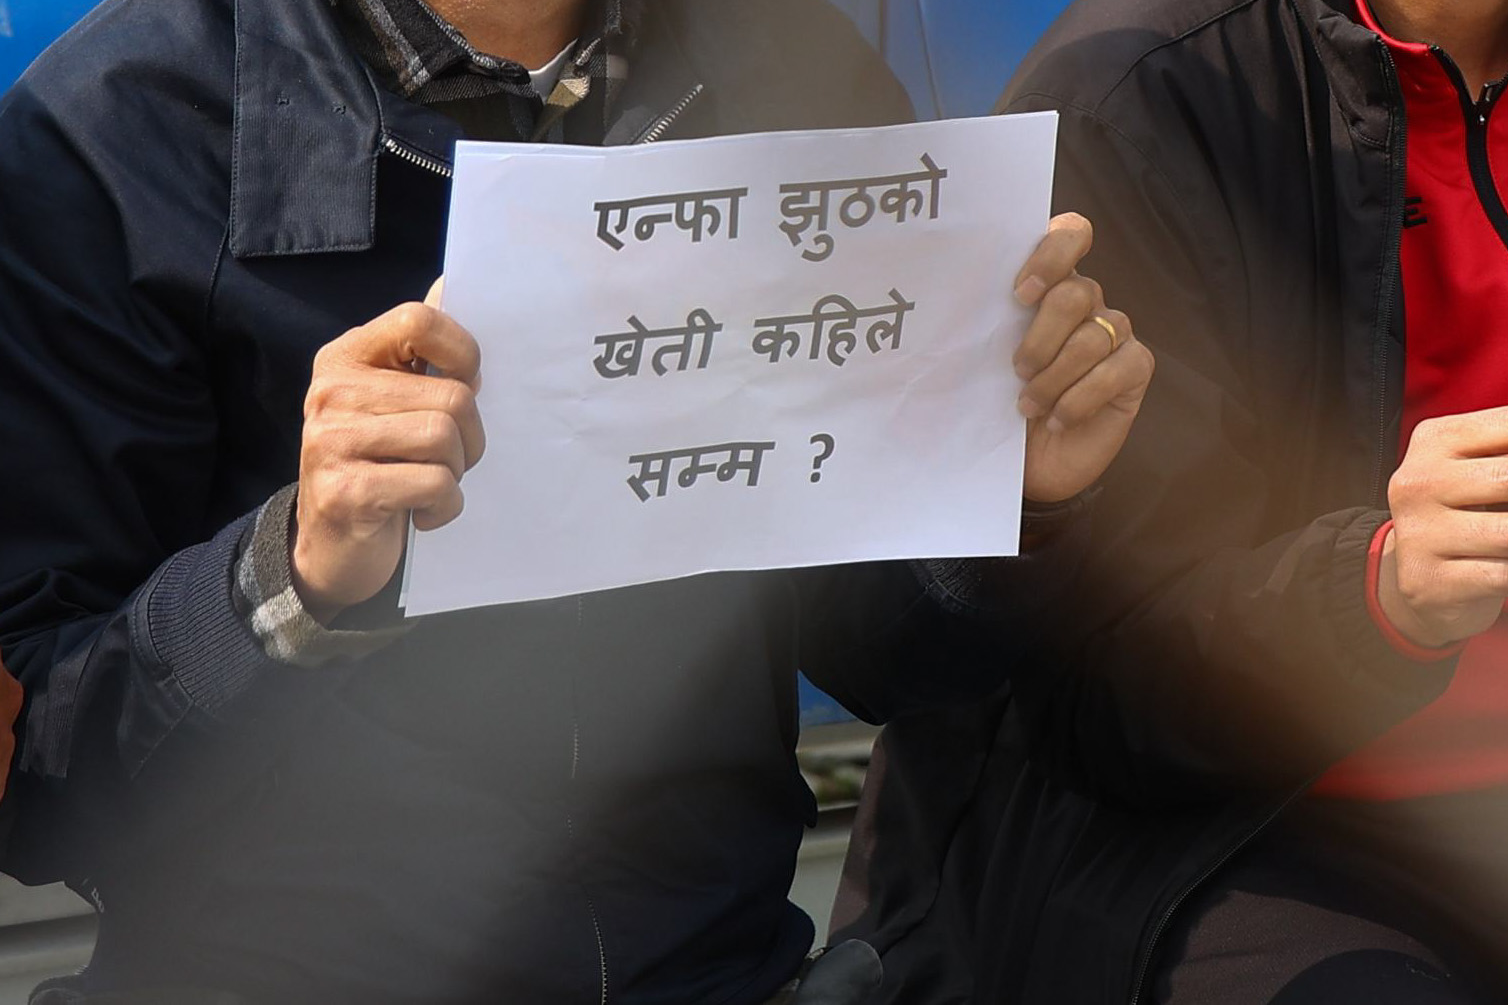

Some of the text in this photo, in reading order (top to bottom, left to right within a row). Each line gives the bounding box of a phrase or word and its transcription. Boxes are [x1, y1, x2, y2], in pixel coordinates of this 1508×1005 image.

[593, 151, 948, 263] एन्फा झुठको
[592, 287, 916, 379] खेती कहिले
[626, 433, 835, 503] सम्म ?
